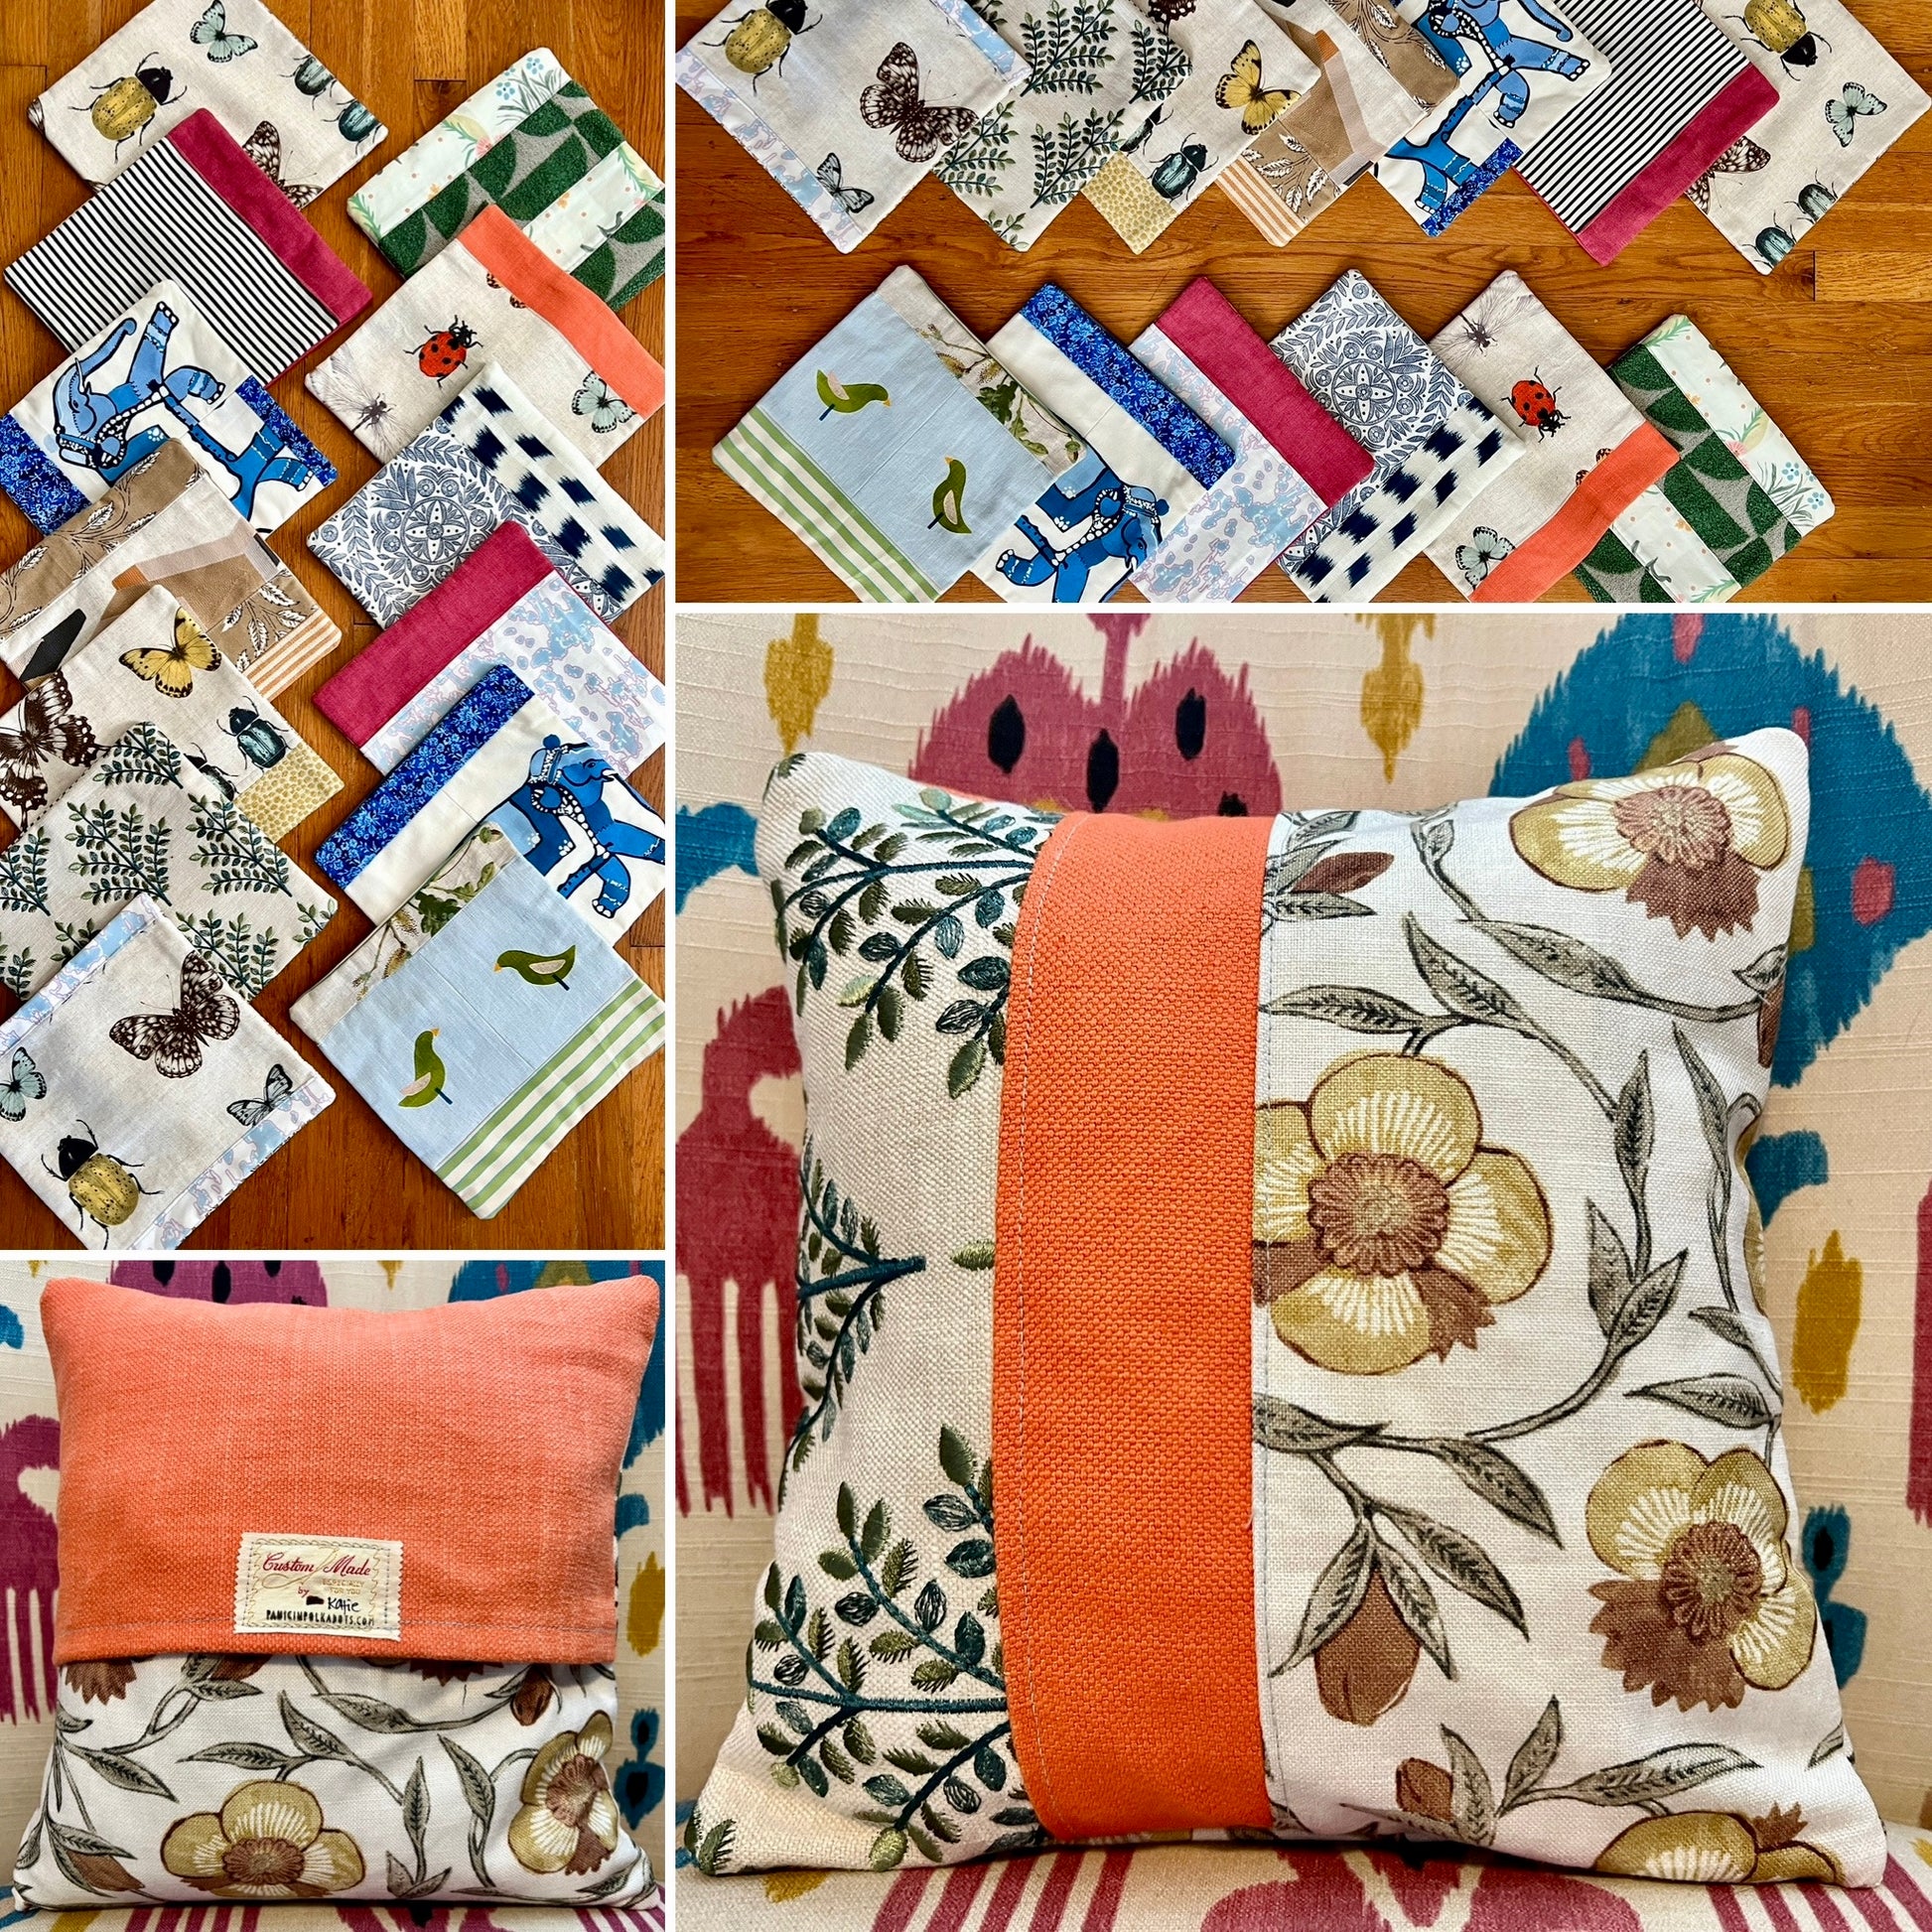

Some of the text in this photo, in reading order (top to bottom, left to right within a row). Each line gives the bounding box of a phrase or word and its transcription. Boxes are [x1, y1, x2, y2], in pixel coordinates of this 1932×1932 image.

[262, 1552, 371, 1577] Custom Made
[298, 1587, 310, 1597] by
[328, 1596, 360, 1614] Katie
[266, 1609, 374, 1625] PANICINPOLKADOTS.COM
